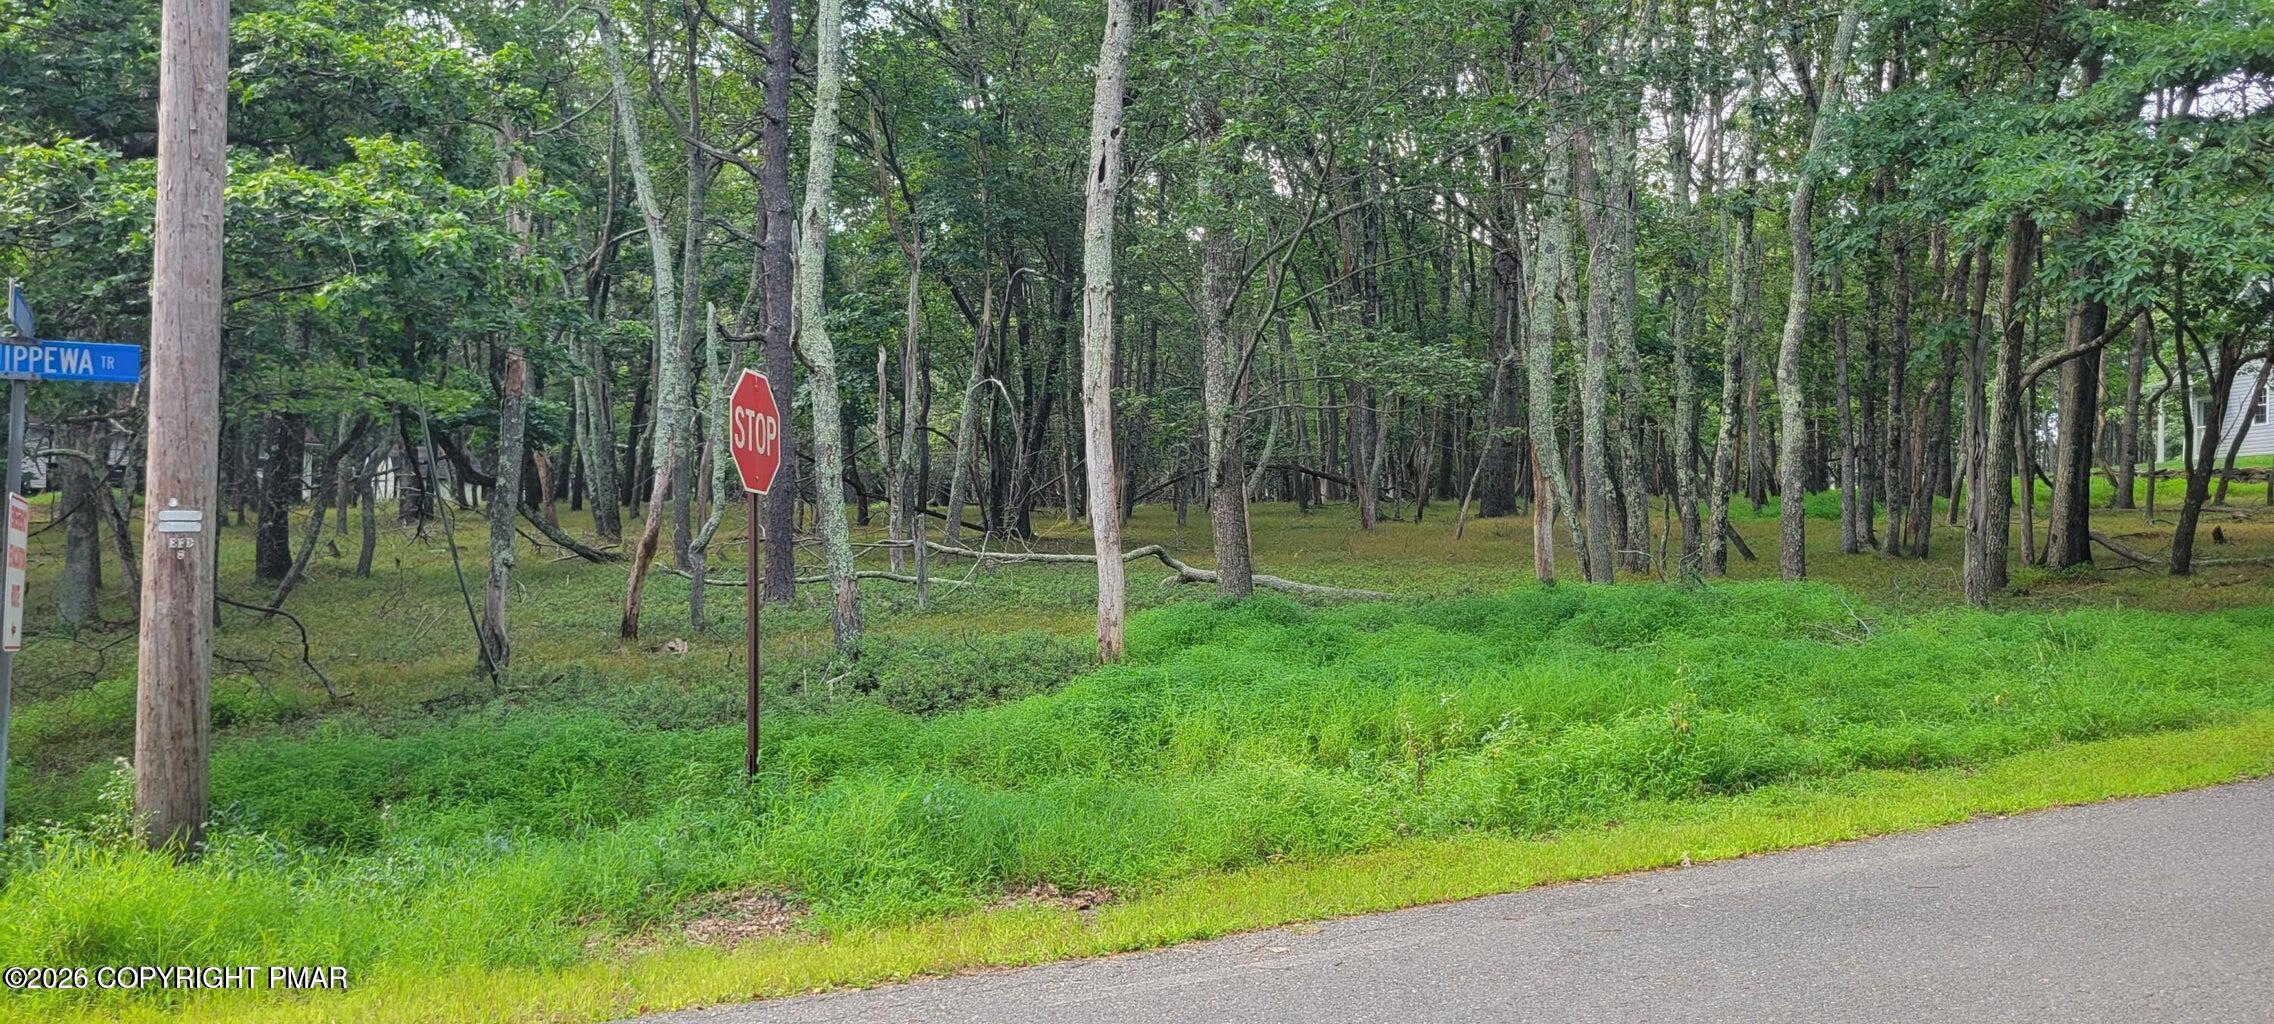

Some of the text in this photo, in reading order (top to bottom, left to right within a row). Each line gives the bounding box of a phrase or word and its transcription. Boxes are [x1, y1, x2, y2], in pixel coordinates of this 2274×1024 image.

[0, 345, 115, 375] IPPEWA TR
[734, 405, 777, 456] STOP
